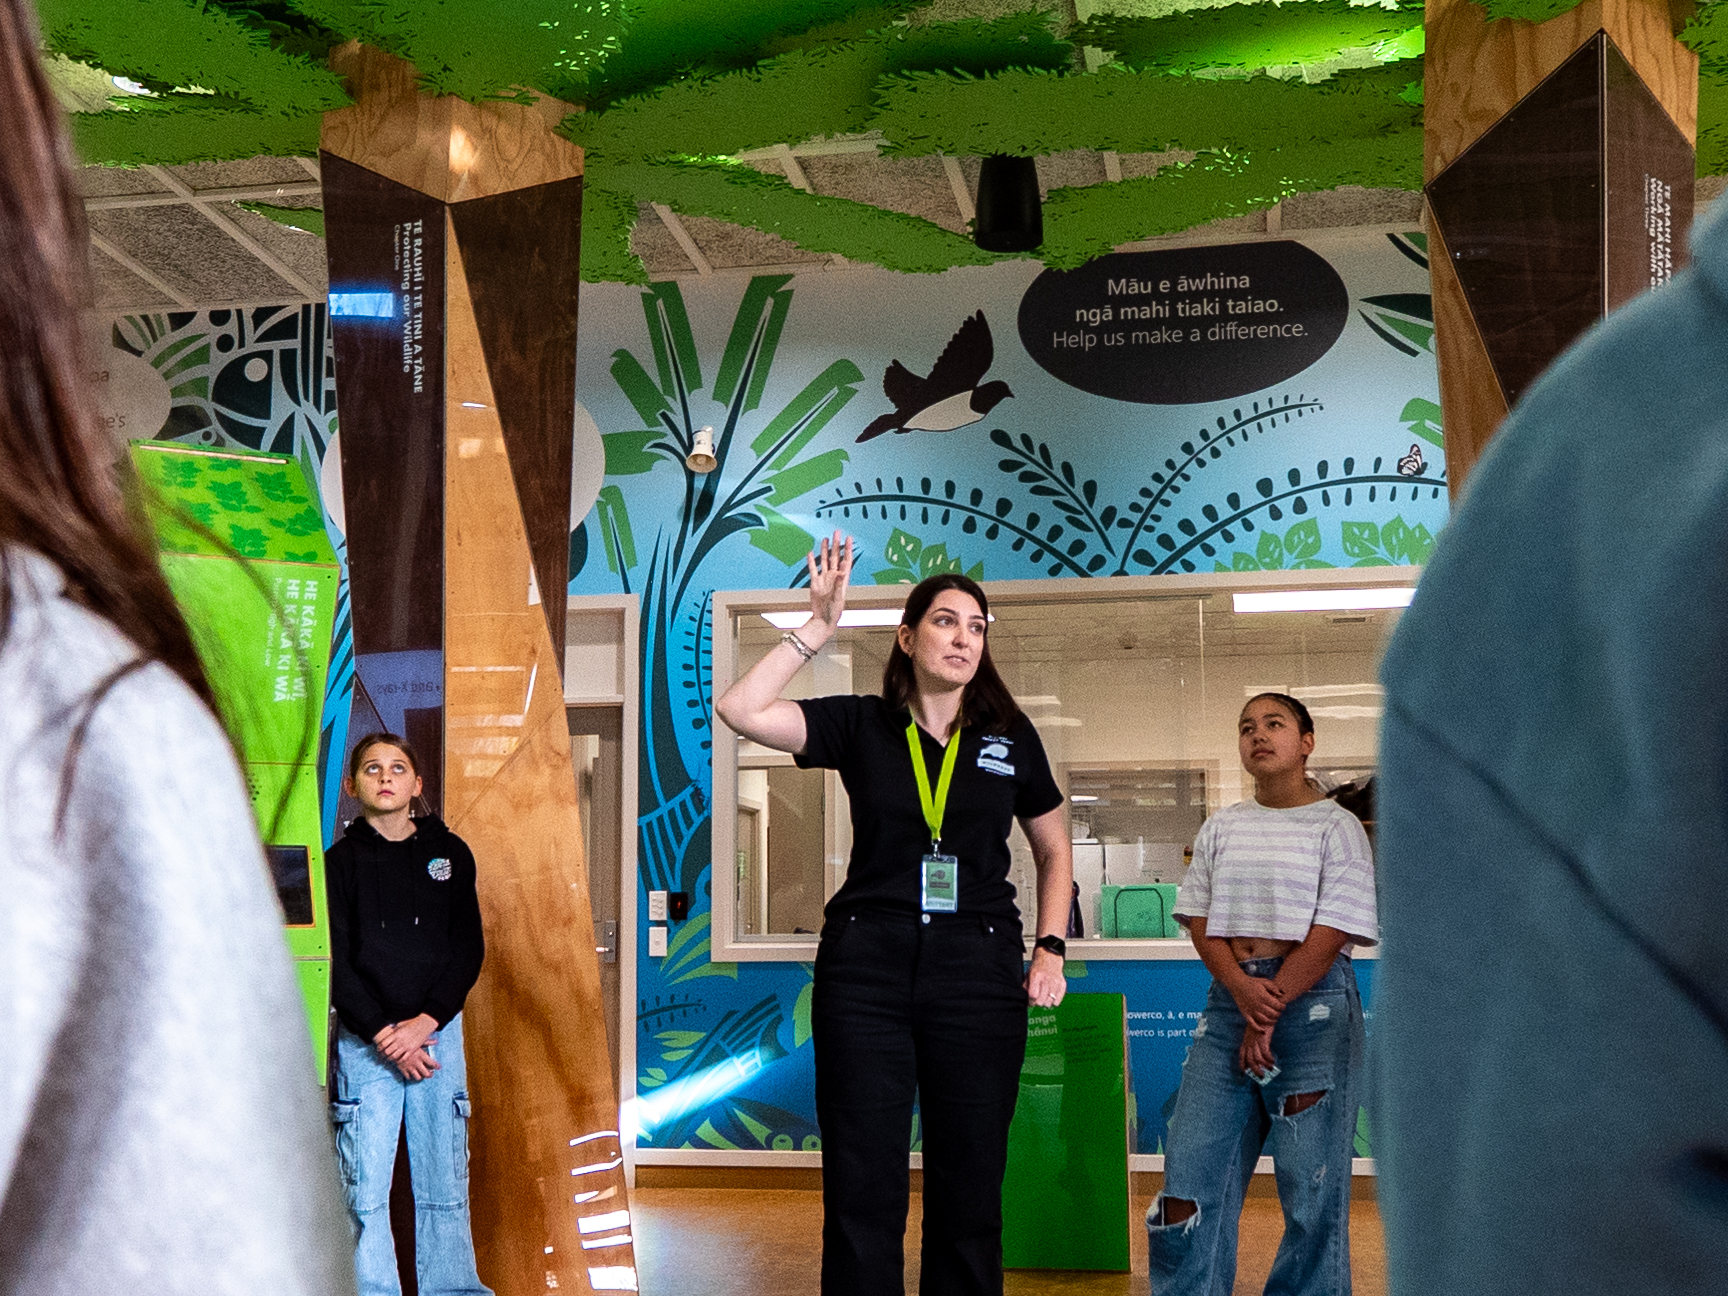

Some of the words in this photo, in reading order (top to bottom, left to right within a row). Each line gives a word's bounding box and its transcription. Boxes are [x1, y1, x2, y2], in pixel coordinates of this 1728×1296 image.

[1649, 178, 1657, 237] Working
[413, 218, 423, 235] TE
[400, 222, 412, 291] Protecting
[1107, 278, 1152, 296] Māu
[1159, 279, 1171, 293] e
[1176, 272, 1251, 292] āwhina
[413, 294, 423, 309] TE
[1075, 304, 1113, 327] ngā
[1120, 300, 1170, 320] mahi
[1176, 297, 1220, 317] tiaki
[1226, 295, 1284, 314] taiao.
[413, 312, 423, 340] TINI
[1053, 329, 1097, 352] Help
[1103, 332, 1125, 346] us
[1131, 325, 1184, 345] make
[1189, 328, 1201, 342] a
[1207, 321, 1309, 341] difference.
[403, 320, 413, 373] Wildlife
[413, 344, 423, 354] A
[413, 357, 425, 394] TĀNE
[286, 579, 300, 599] HE
[304, 580, 318, 600] HE
[299, 605, 317, 649] KĀKĀ
[276, 654, 292, 671] KI
[273, 674, 292, 702] WĀ
[1127, 1011, 1165, 1021] owerco,
[1186, 1011, 1203, 1020] ma
[1128, 1028, 1155, 1037] werco
[1167, 1028, 1187, 1039] part
